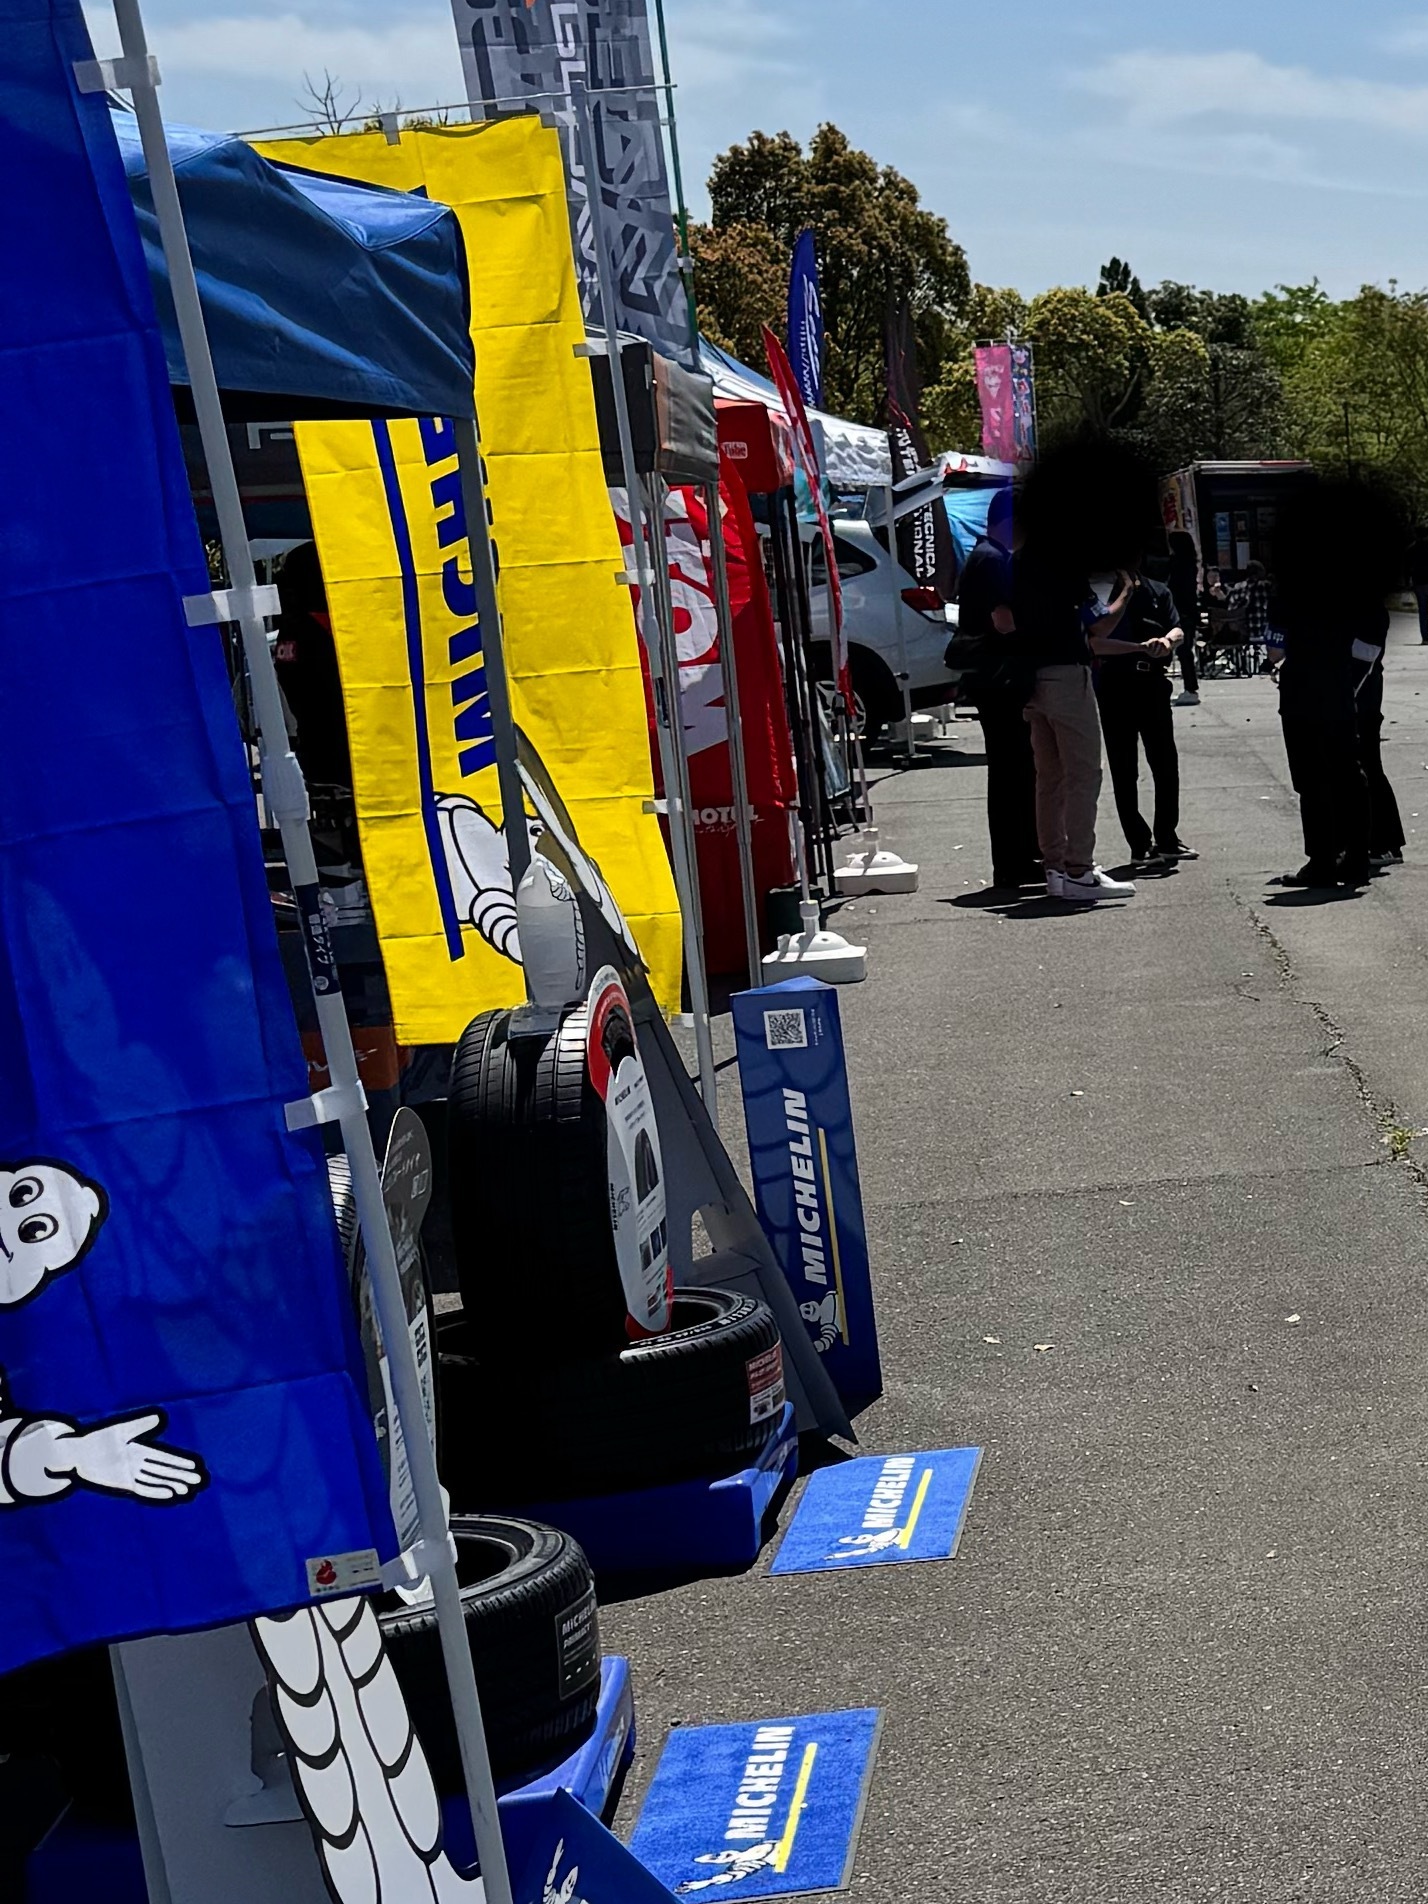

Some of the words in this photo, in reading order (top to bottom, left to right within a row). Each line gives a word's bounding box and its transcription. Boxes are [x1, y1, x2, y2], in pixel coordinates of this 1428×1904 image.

[782, 1087, 828, 1285] MICHELIN
[861, 1456, 916, 1529] MICHELIN
[724, 1725, 796, 1840] MICHELIN
